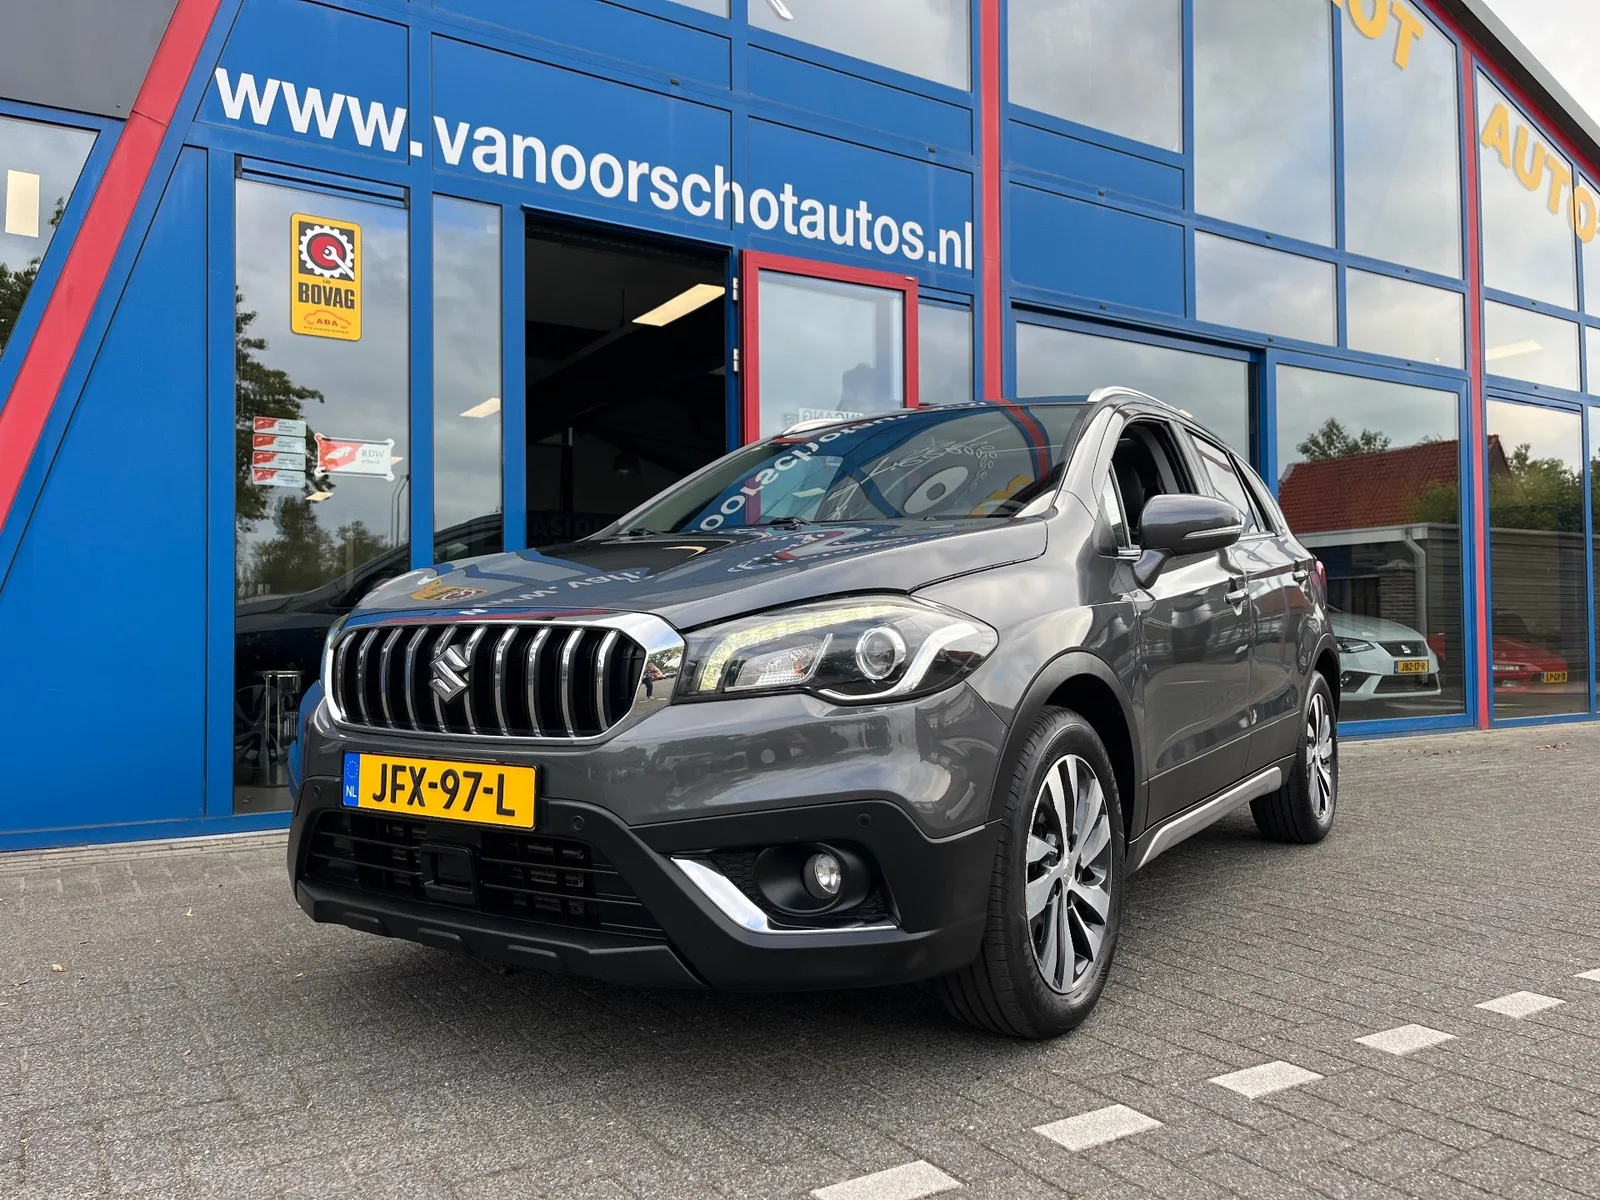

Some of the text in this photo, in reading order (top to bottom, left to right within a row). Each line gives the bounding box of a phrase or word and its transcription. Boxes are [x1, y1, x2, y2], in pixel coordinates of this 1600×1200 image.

[215, 67, 973, 270] www.vanoorschotautos.nl
[298, 282, 355, 310] BOVAG
[316, 318, 338, 326] ABA
[362, 449, 384, 457] RDW
[345, 763, 515, 817] NL JFX-97-L
